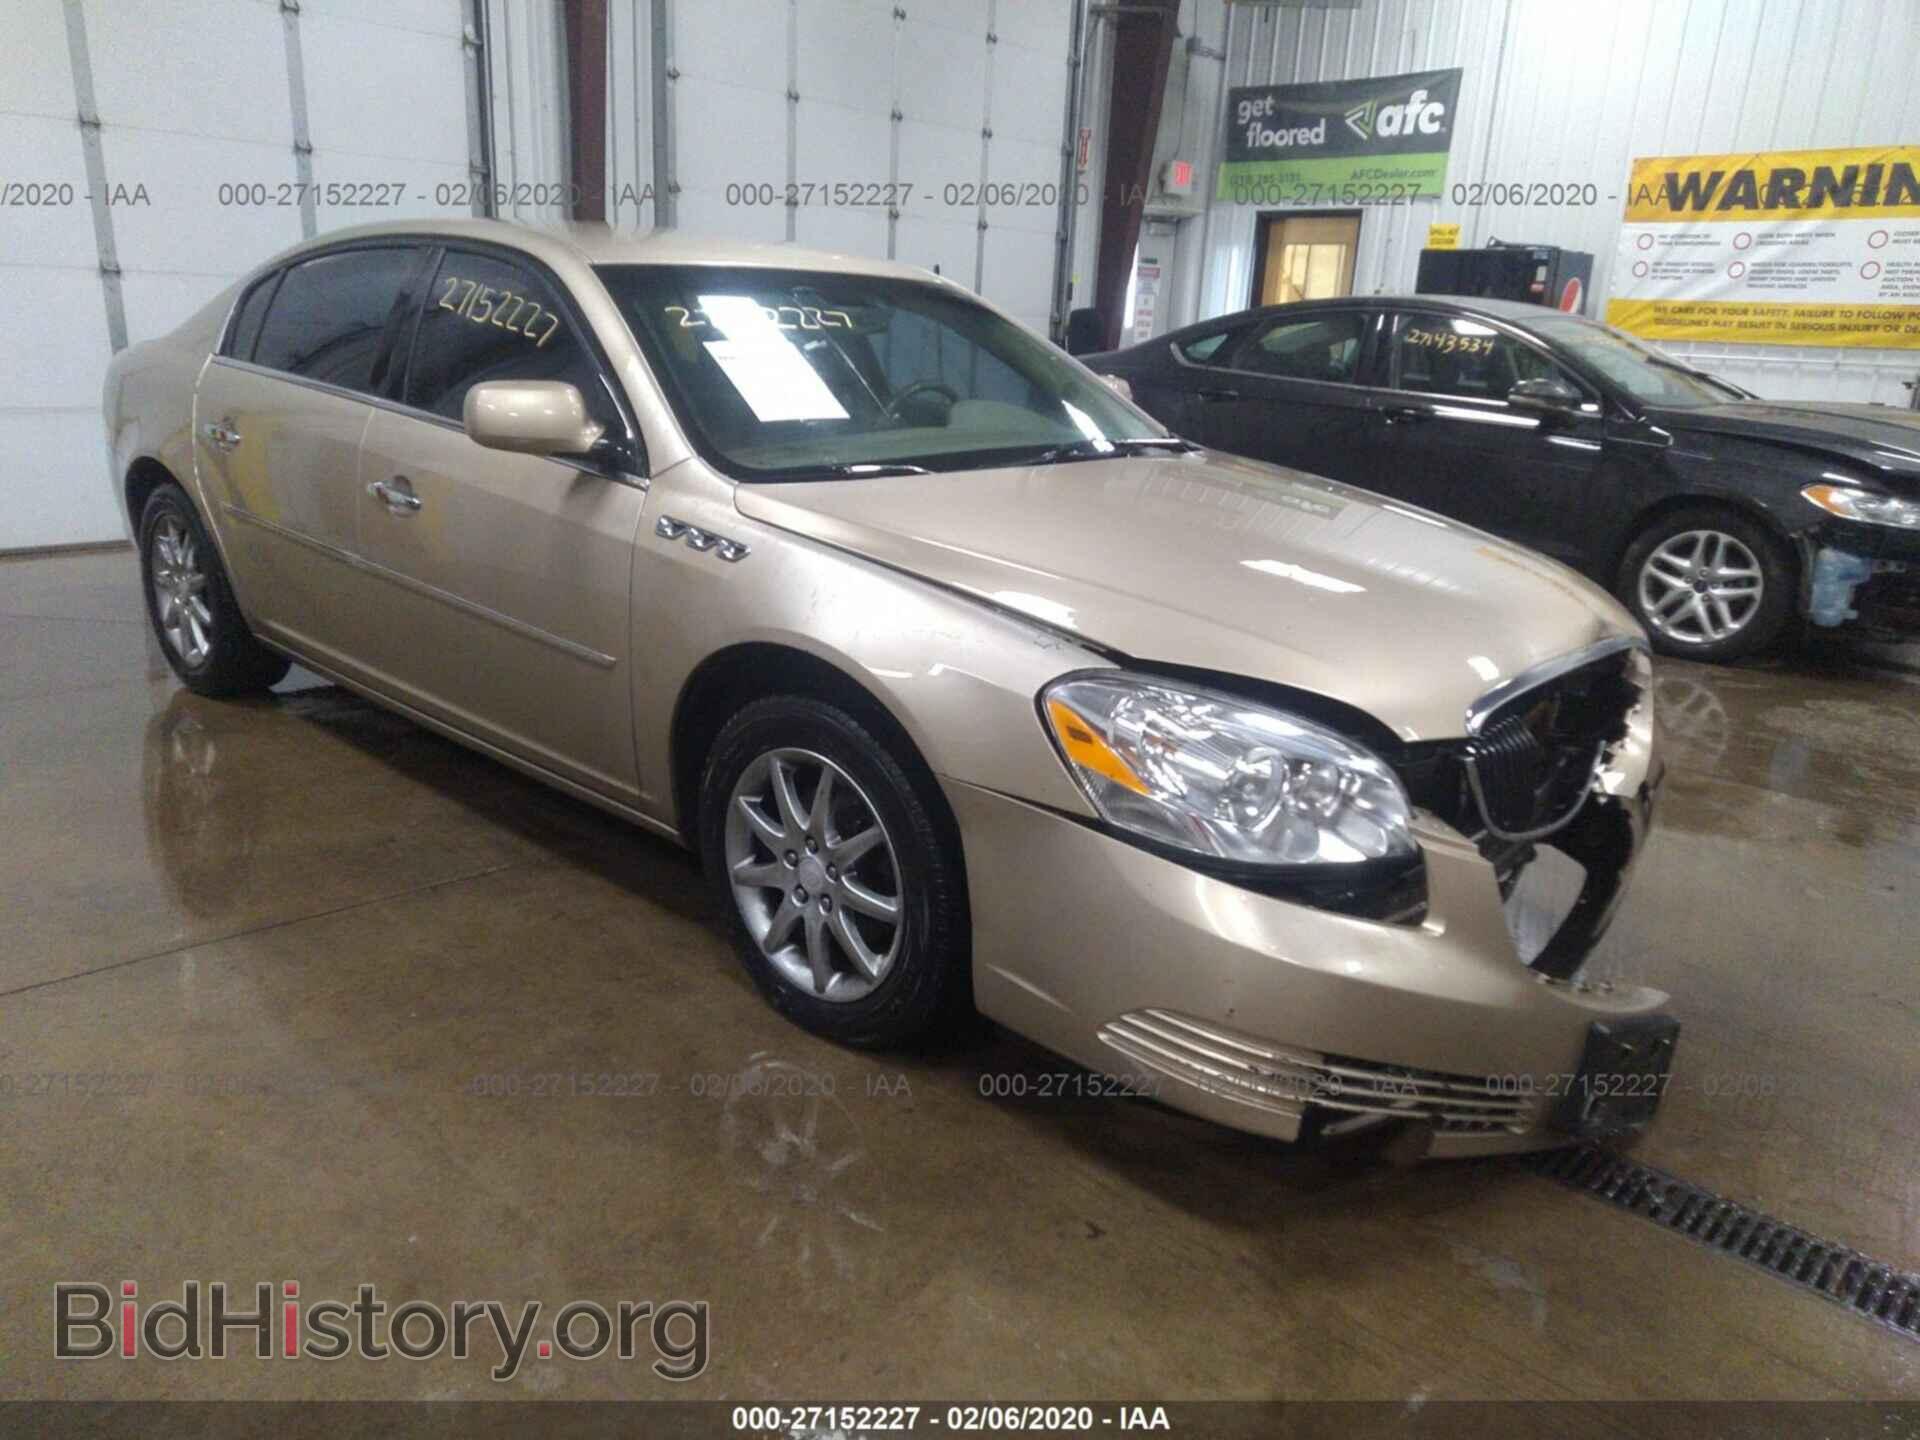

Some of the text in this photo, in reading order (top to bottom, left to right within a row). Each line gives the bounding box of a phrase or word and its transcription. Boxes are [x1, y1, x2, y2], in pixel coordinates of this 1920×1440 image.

[1237, 97, 1274, 124] get
[1376, 89, 1444, 137] afc
[1247, 118, 1326, 147] floored
[440, 277, 559, 347] 27152227
[1840, 309, 1854, 318] TO
[1857, 310, 1905, 320] FOLLOW
